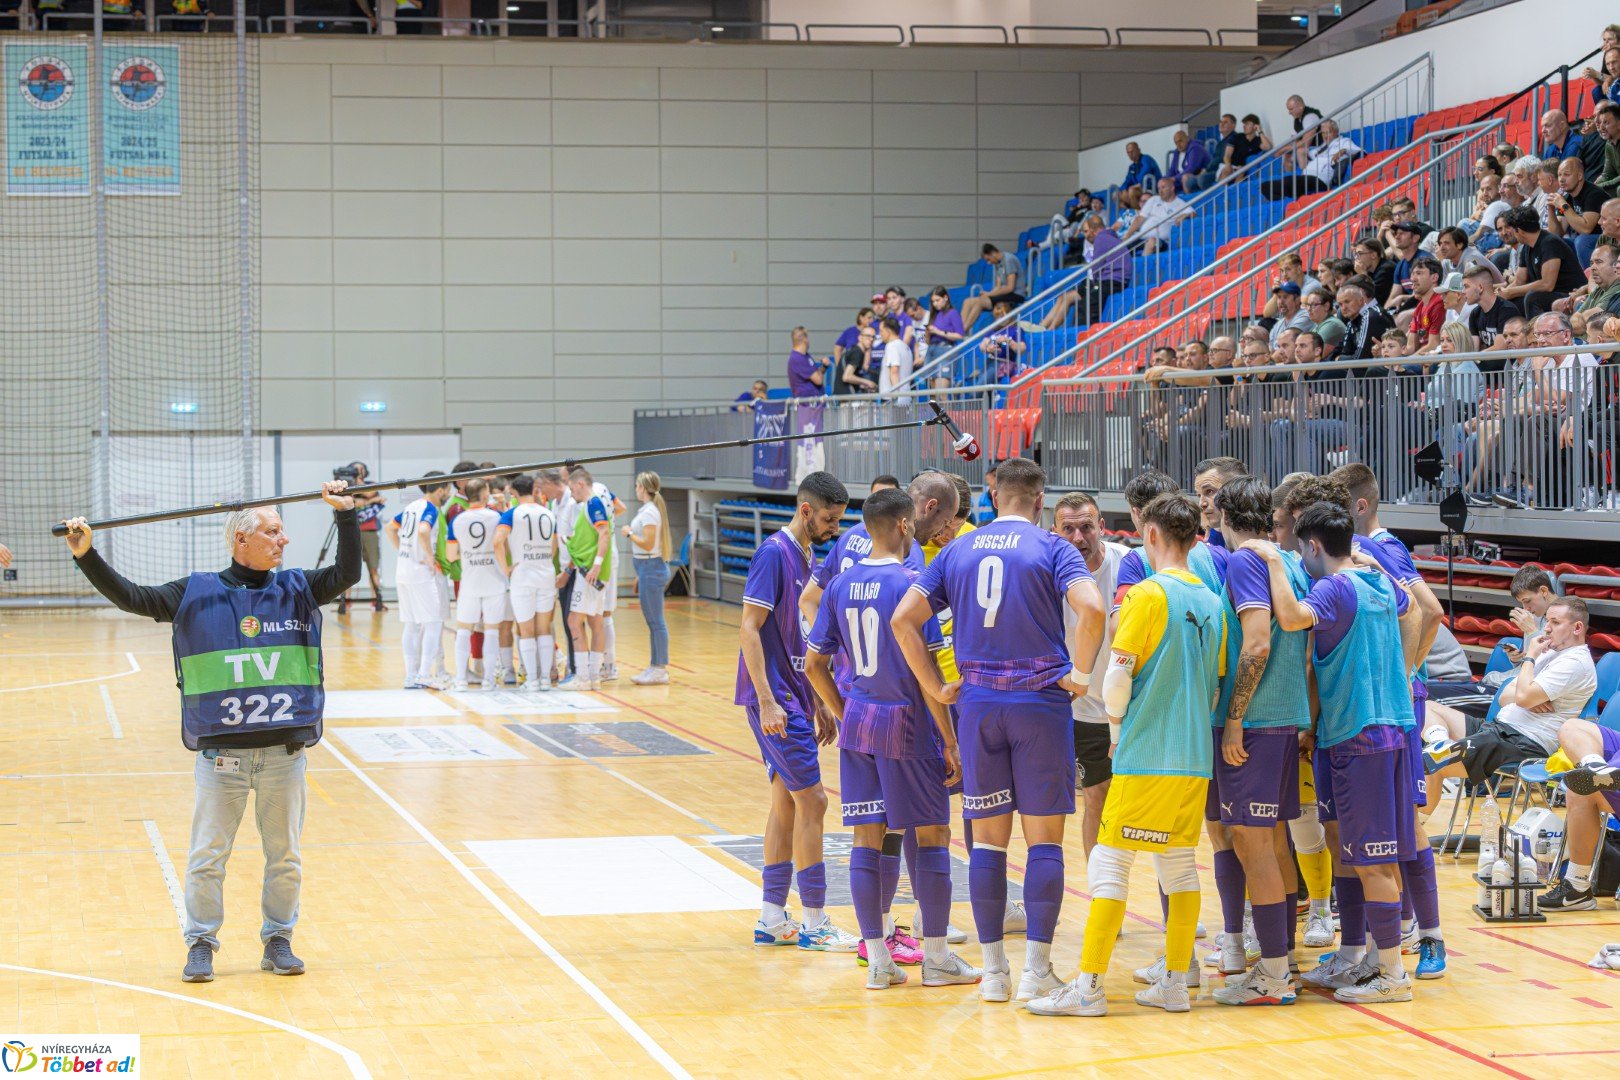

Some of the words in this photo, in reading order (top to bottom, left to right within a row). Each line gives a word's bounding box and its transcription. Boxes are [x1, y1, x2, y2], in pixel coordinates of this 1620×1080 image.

[469, 521, 486, 549] 9
[522, 513, 553, 541] 10
[972, 531, 1021, 550] SUSCSÁK
[849, 582, 881, 600] THIAGO
[977, 555, 1004, 628] 9
[845, 606, 880, 678] 10
[224, 651, 281, 683] TV
[220, 693, 294, 726] 322
